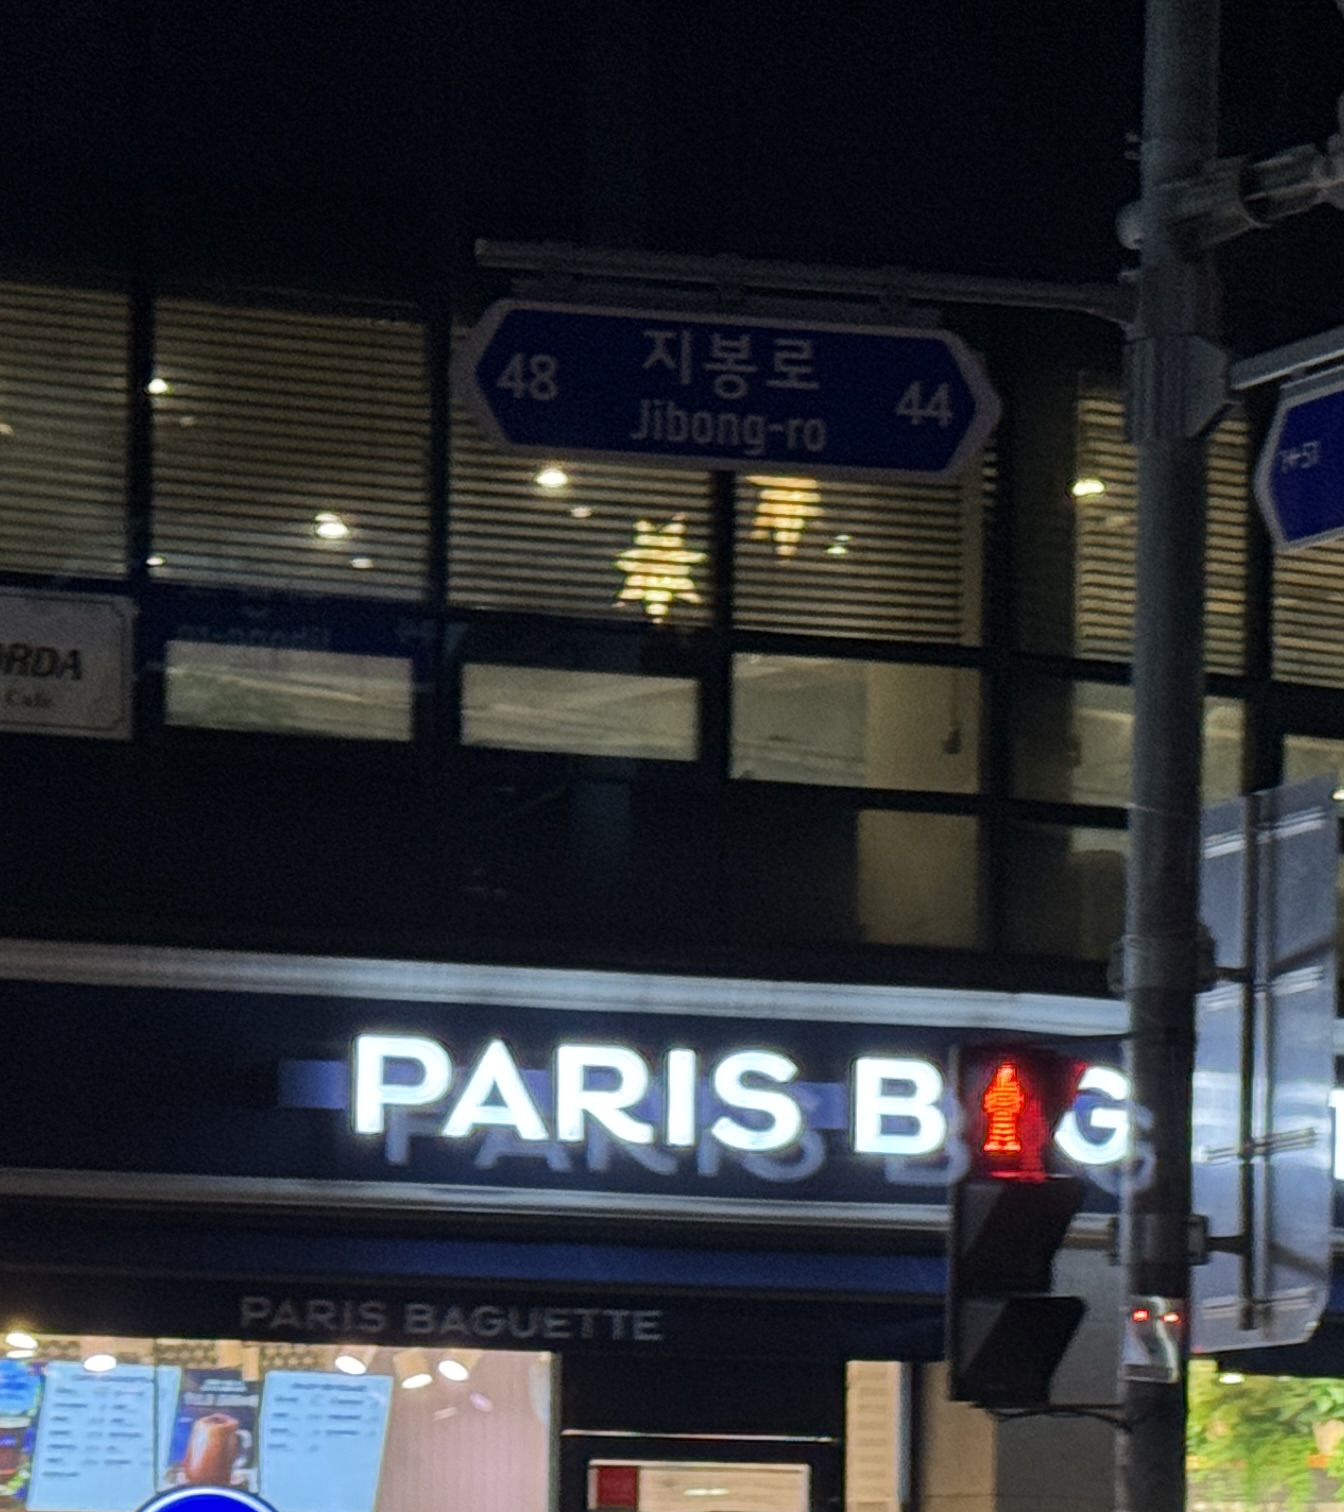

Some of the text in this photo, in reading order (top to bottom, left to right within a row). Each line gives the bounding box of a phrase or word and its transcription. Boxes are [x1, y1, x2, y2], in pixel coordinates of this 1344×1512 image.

[496, 328, 956, 428] 48 지봉로 44
[629, 398, 829, 456] Jibong-ro
[352, 1034, 804, 1154] PARIS
[239, 1296, 663, 1343] PARIS BAGUETTE
